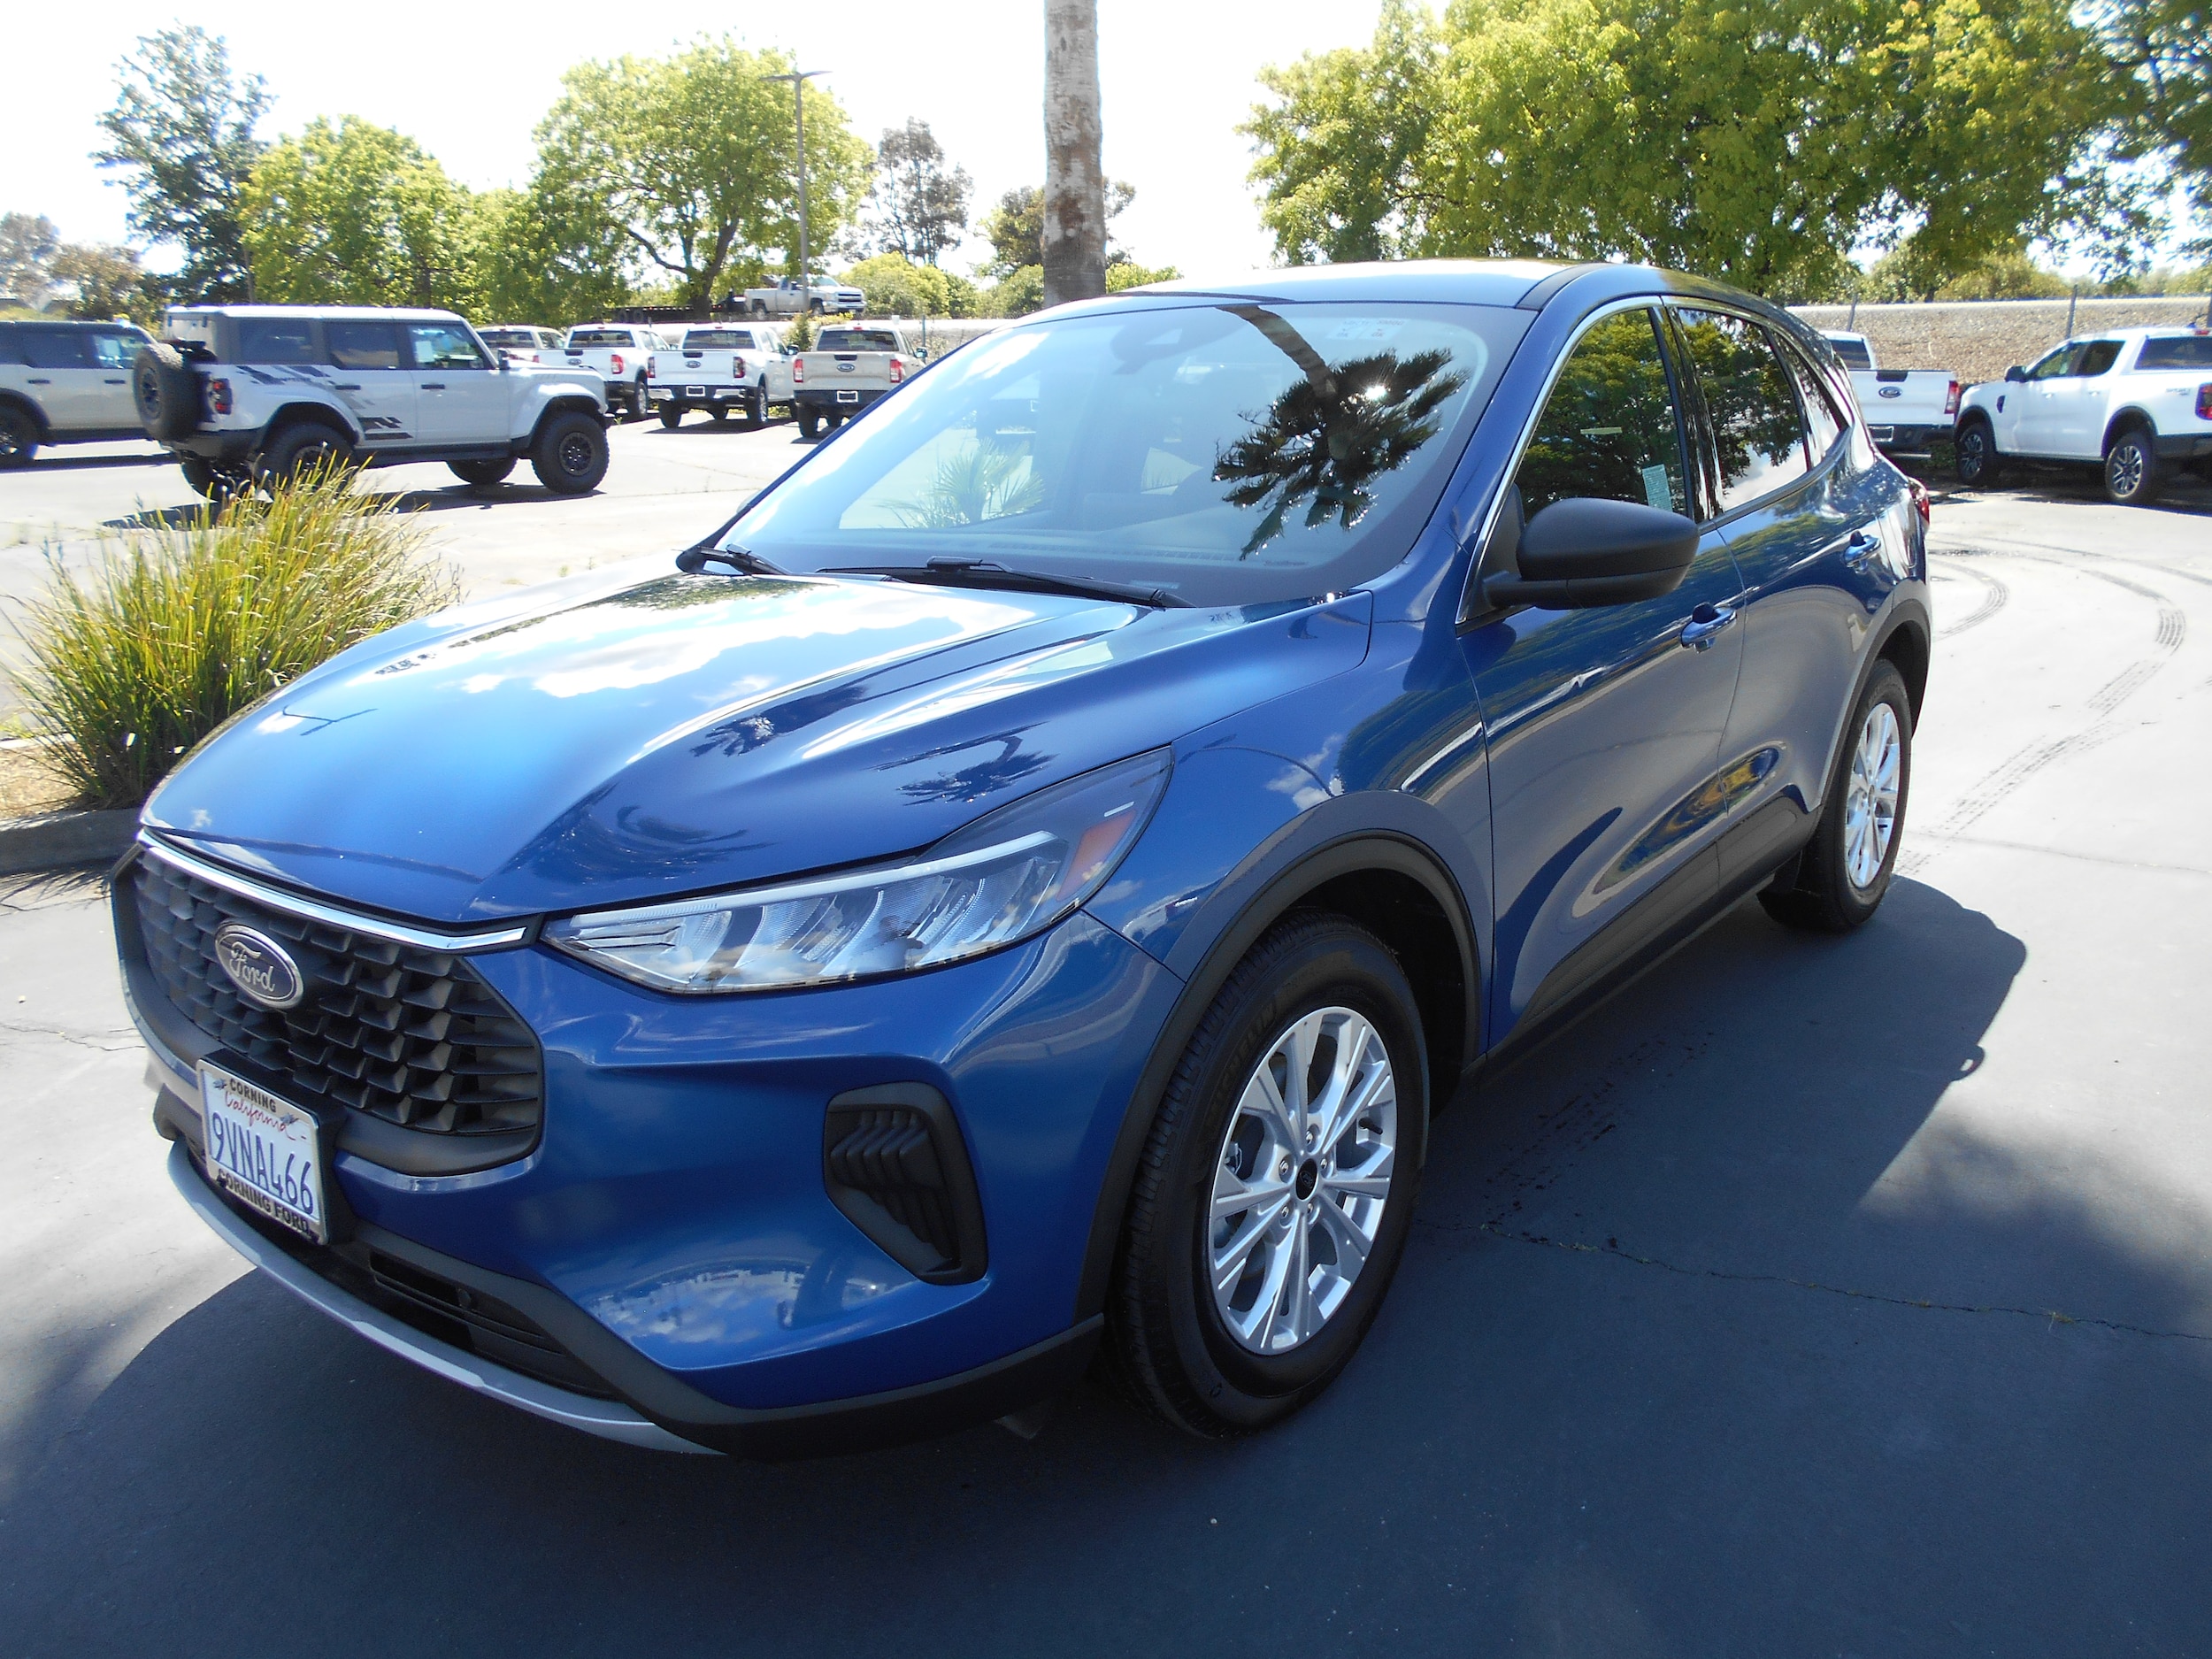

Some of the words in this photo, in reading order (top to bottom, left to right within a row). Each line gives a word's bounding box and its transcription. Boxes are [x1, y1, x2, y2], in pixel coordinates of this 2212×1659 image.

[231, 941, 277, 991] Ford
[225, 1091, 296, 1141] California
[229, 1077, 277, 1112] CORNING
[212, 1112, 313, 1215] 9VNA466
[218, 1168, 272, 1212] CORNING
[274, 1202, 309, 1233] FORD
